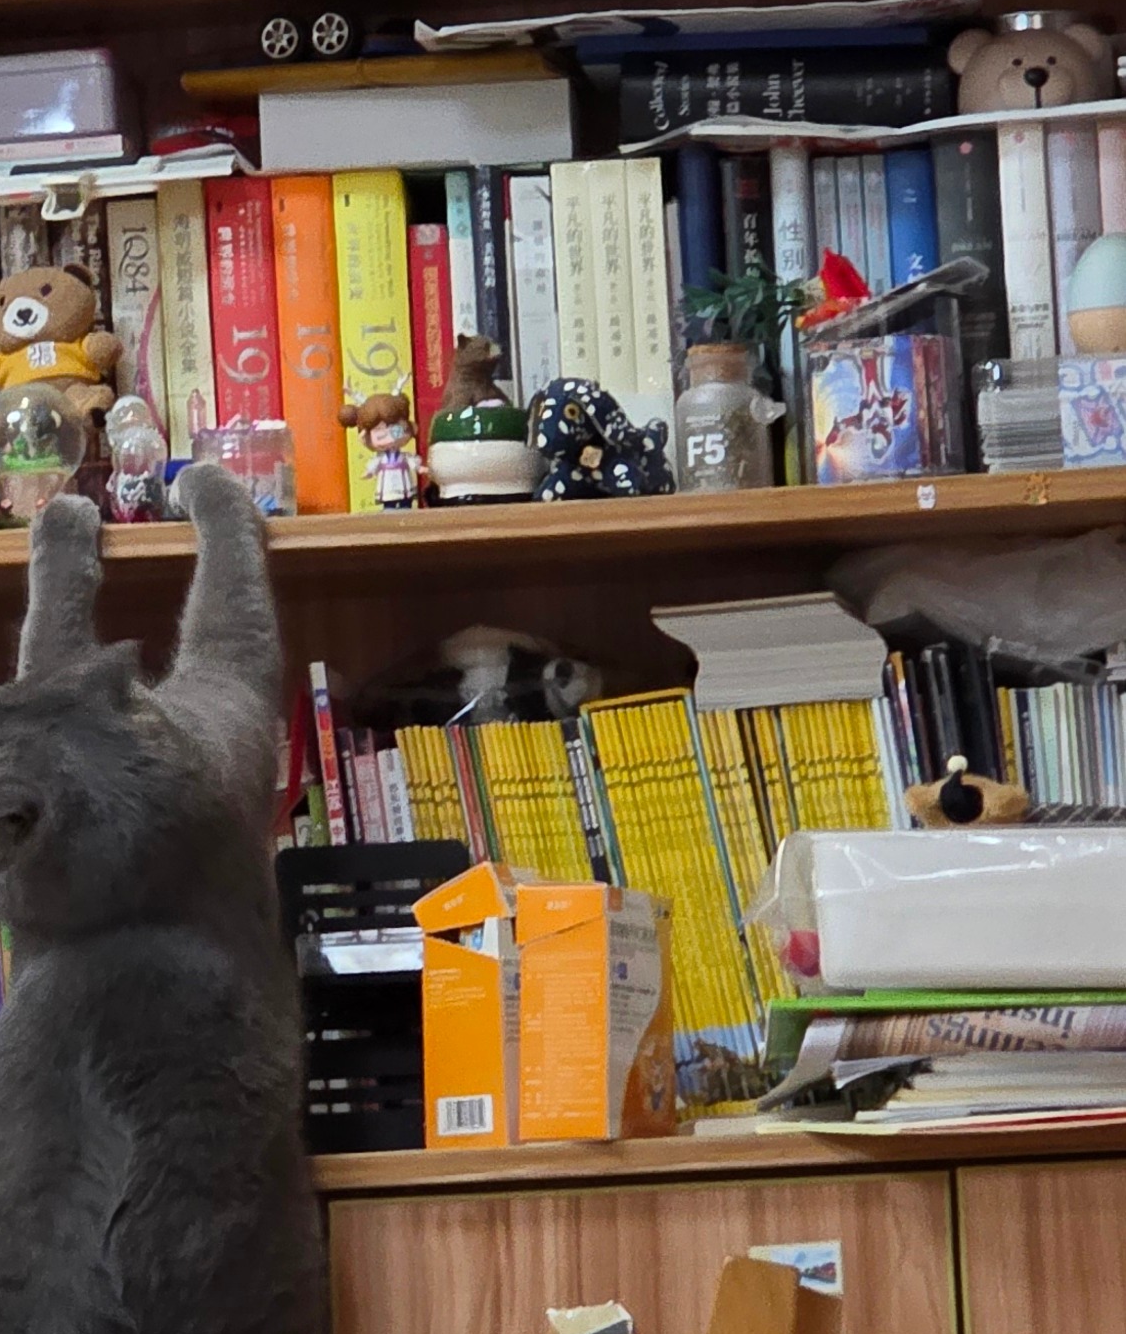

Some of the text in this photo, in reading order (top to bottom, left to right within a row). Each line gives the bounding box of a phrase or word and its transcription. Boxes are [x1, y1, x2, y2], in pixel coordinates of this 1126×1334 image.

[638, 192, 656, 273] 平凡的世界
[779, 219, 804, 271] 性别
[218, 325, 271, 385] 19
[289, 322, 334, 380] 19
[347, 317, 400, 378] 19
[687, 433, 725, 467] F5
